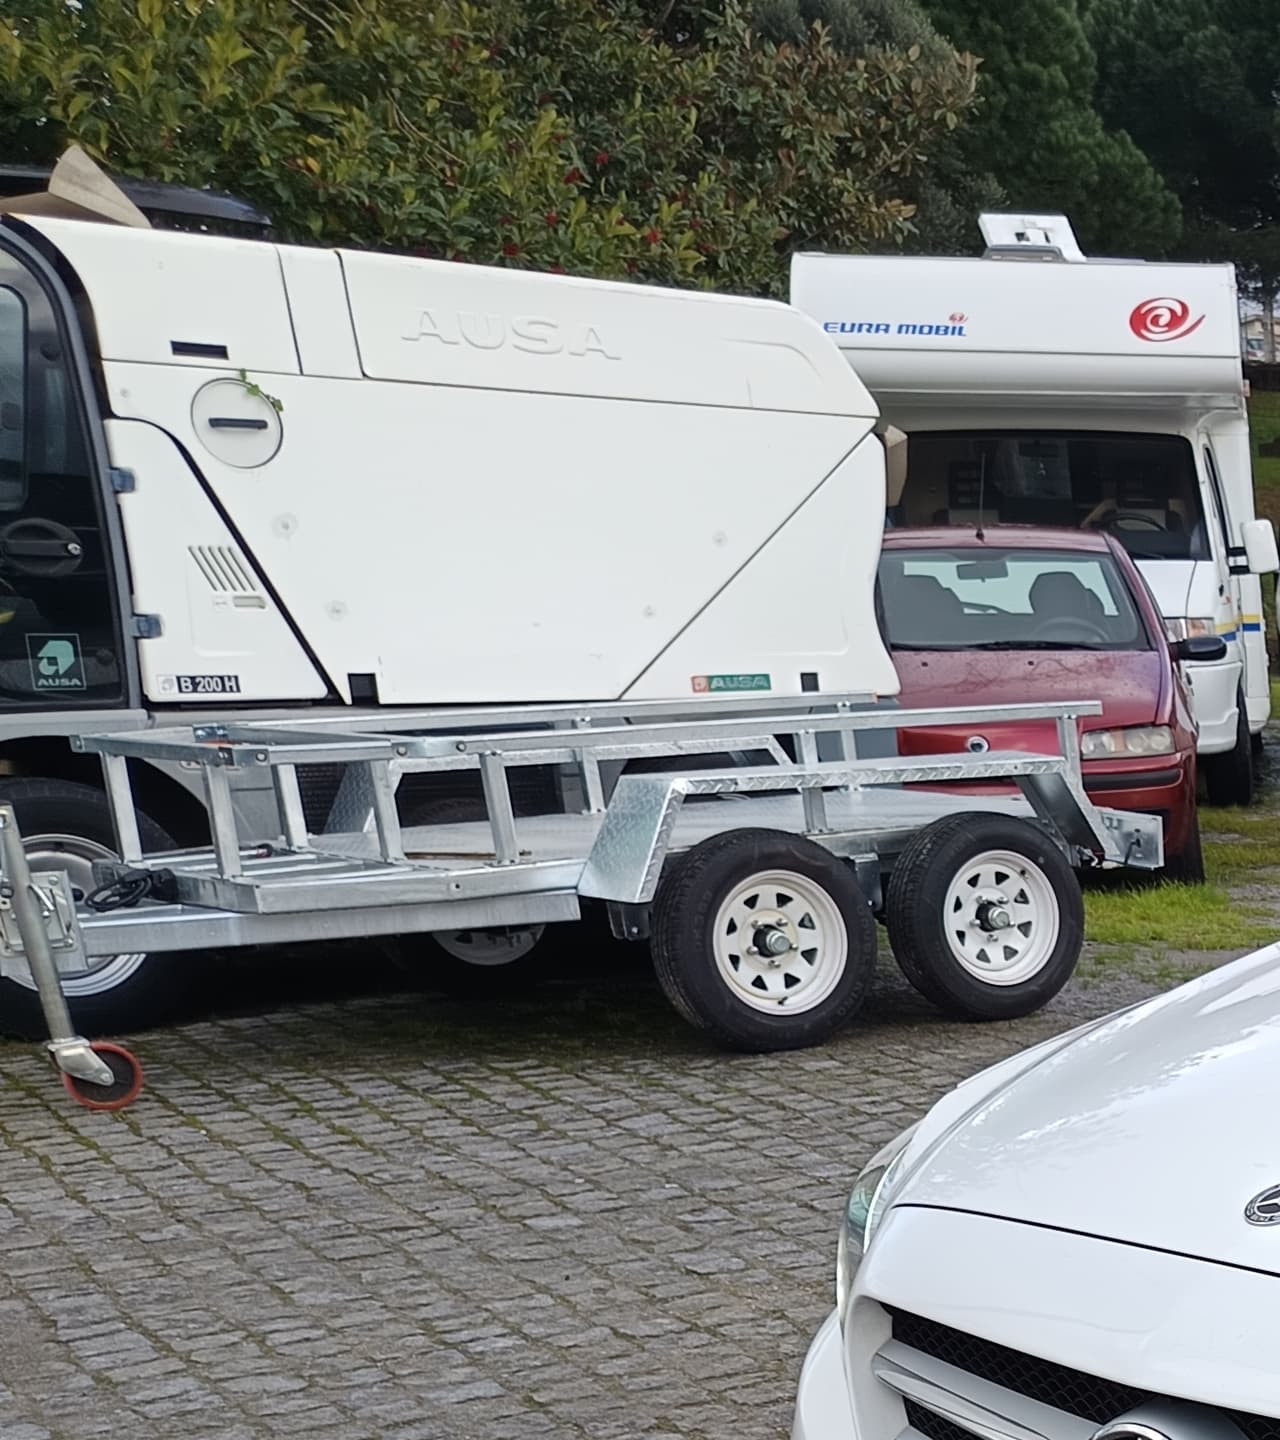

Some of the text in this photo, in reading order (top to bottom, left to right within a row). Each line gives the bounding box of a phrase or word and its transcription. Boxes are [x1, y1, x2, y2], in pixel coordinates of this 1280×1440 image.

[399, 308, 623, 361] AUSA
[823, 322, 967, 337] EURA MOBIL
[36, 678, 82, 687] AUSA
[180, 677, 238, 692] B 200 H
[711, 676, 769, 688] AUSA
